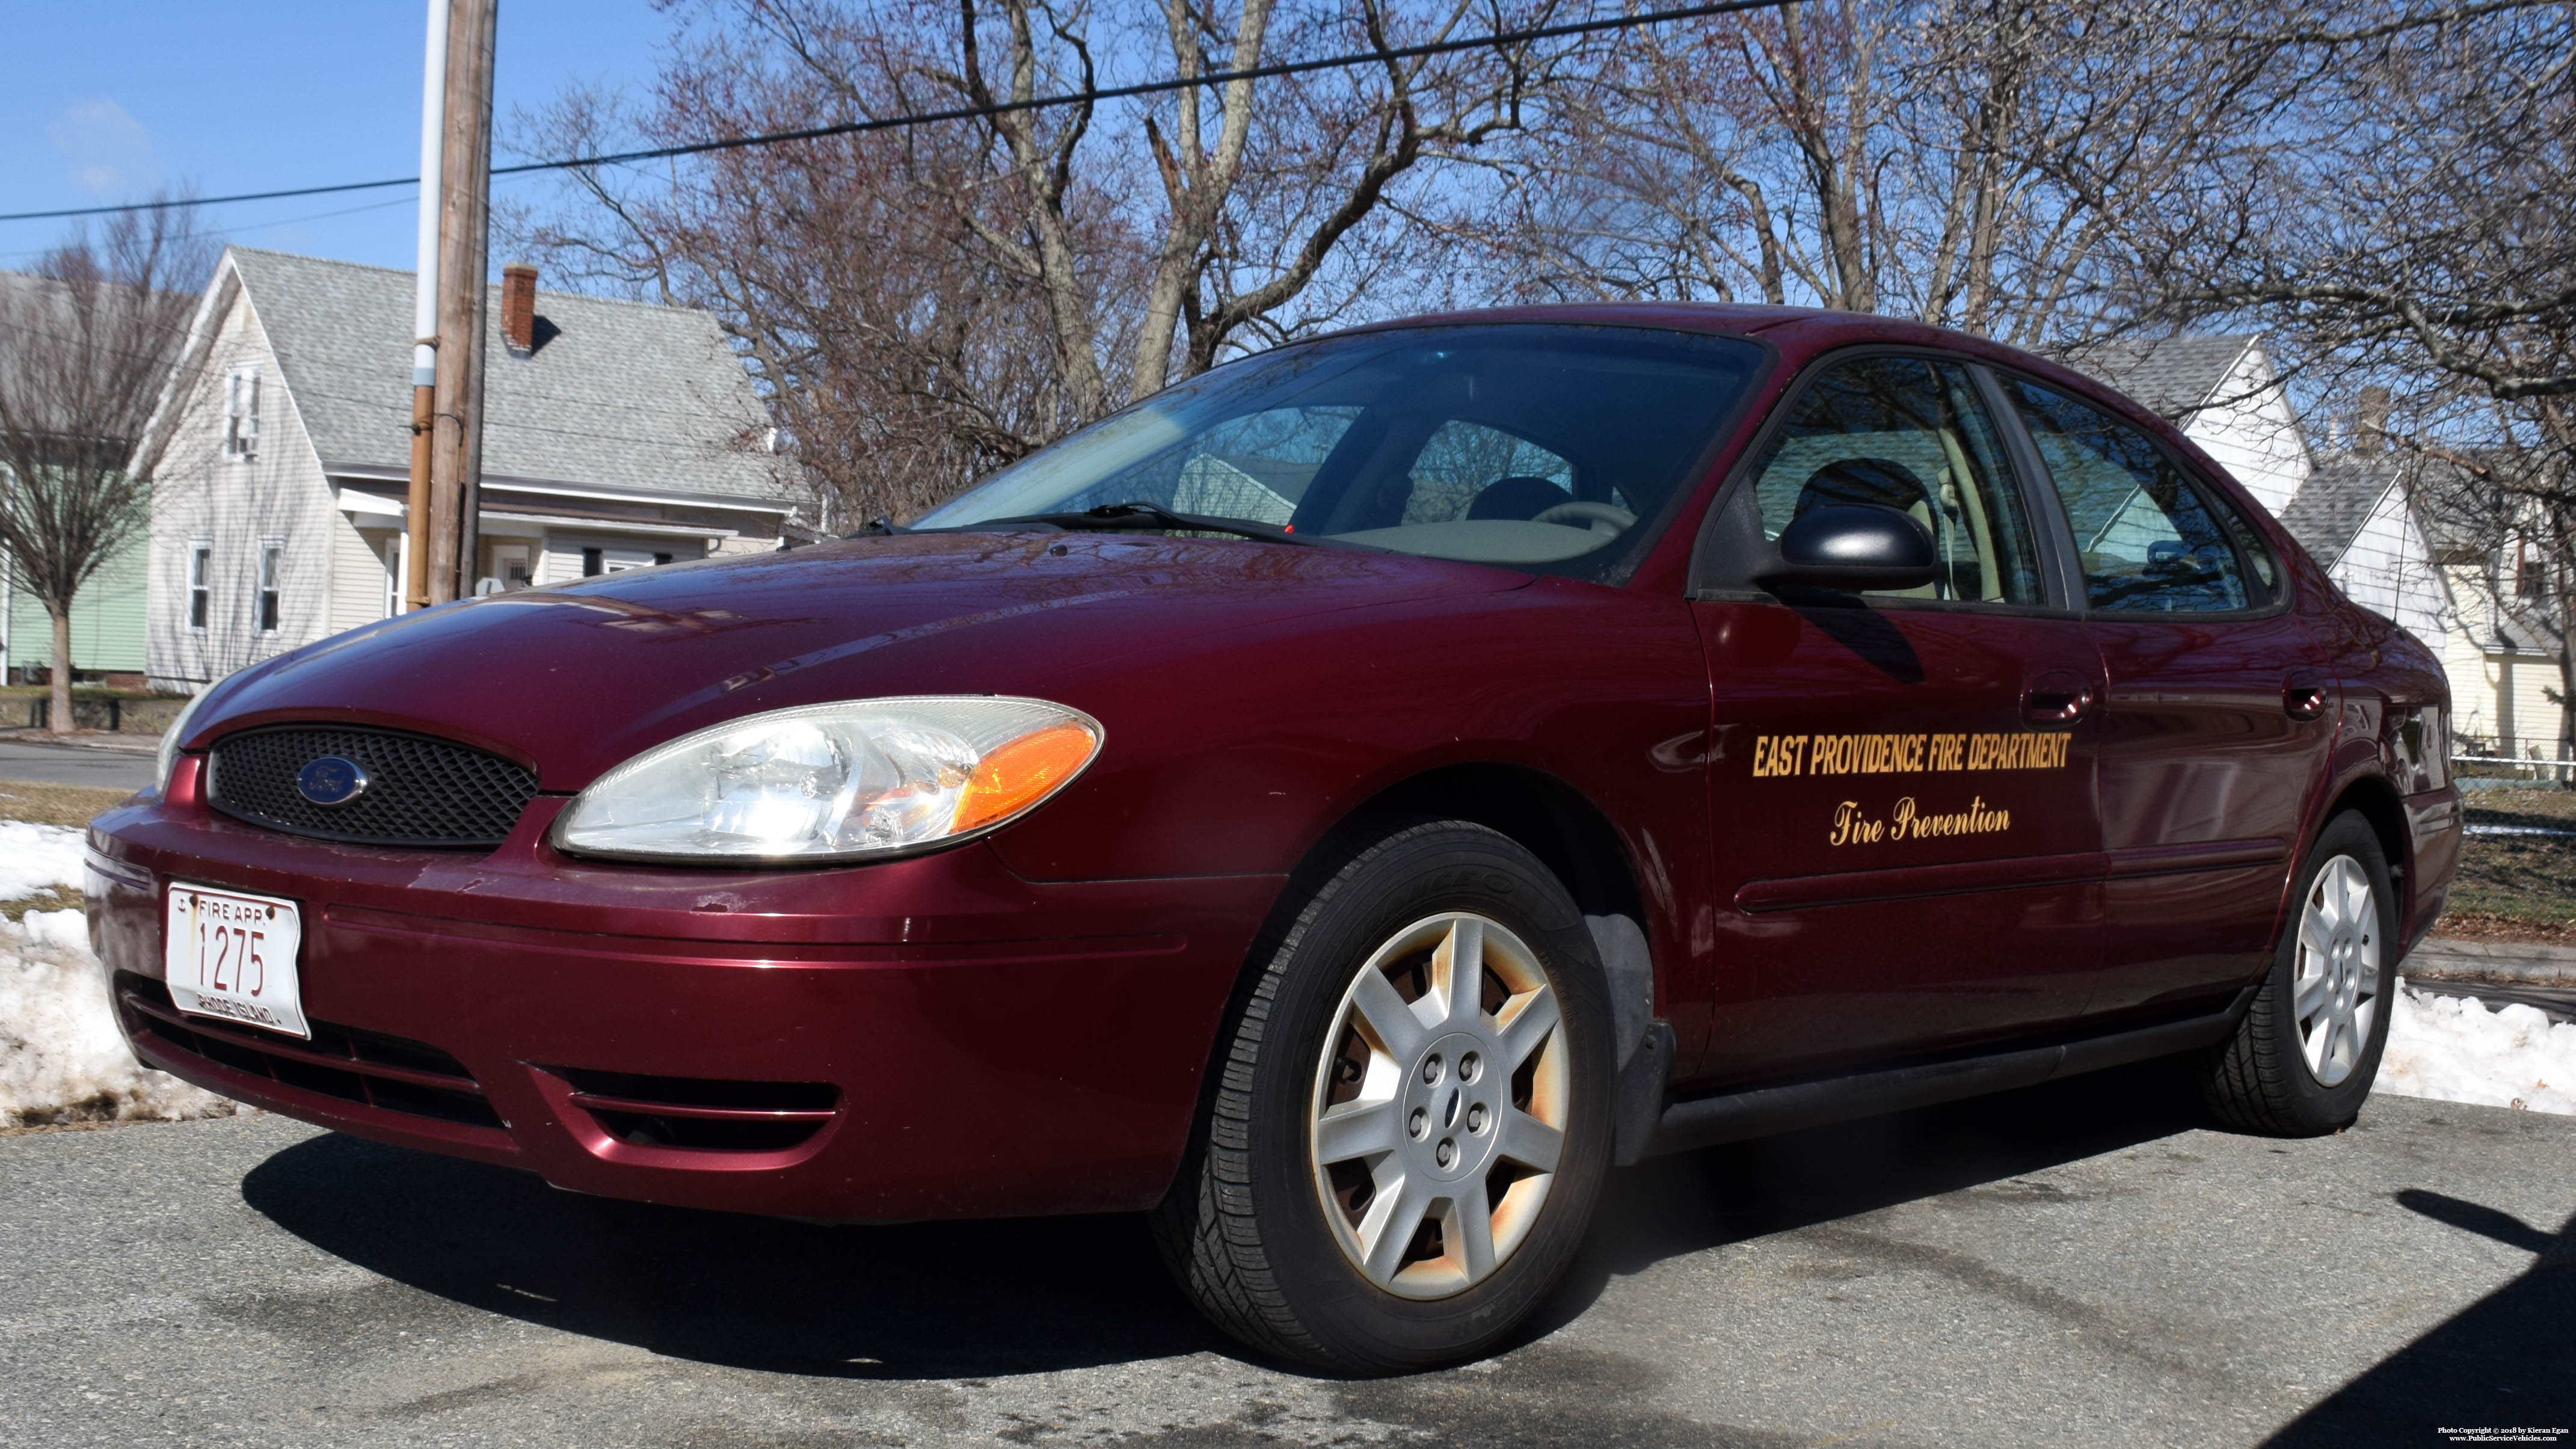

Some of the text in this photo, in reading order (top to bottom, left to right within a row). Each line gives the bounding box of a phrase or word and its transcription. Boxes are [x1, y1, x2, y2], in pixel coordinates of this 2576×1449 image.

[1753, 732, 2071, 777] EAST PROVIDENCE FIRE DEPARTMENT
[1830, 796, 2010, 846] Fire Prevention
[199, 900, 230, 920] FIRE
[200, 923, 264, 996] 1275
[197, 993, 275, 1026] RHODE ISLAND
